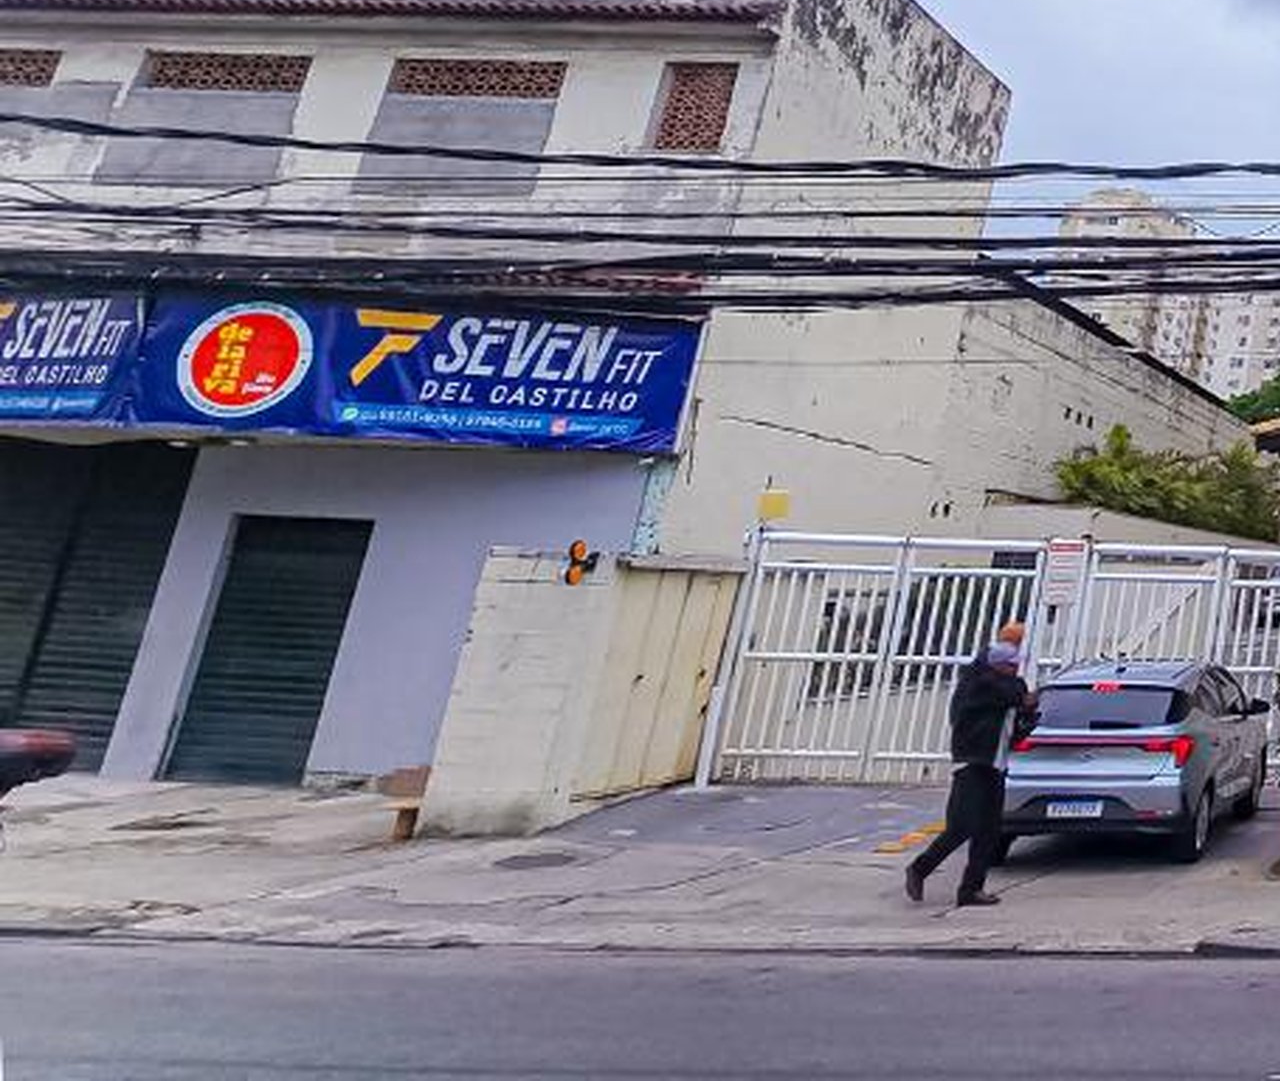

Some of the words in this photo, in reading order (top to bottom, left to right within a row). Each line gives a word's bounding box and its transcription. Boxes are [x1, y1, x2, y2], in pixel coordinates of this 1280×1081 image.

[3, 299, 111, 358] SEVEN
[92, 320, 131, 355] FIT
[433, 317, 618, 382] SEVEN
[605, 349, 663, 384] FIT
[420, 380, 475, 404] DEL
[490, 385, 637, 411] CASTILHO
